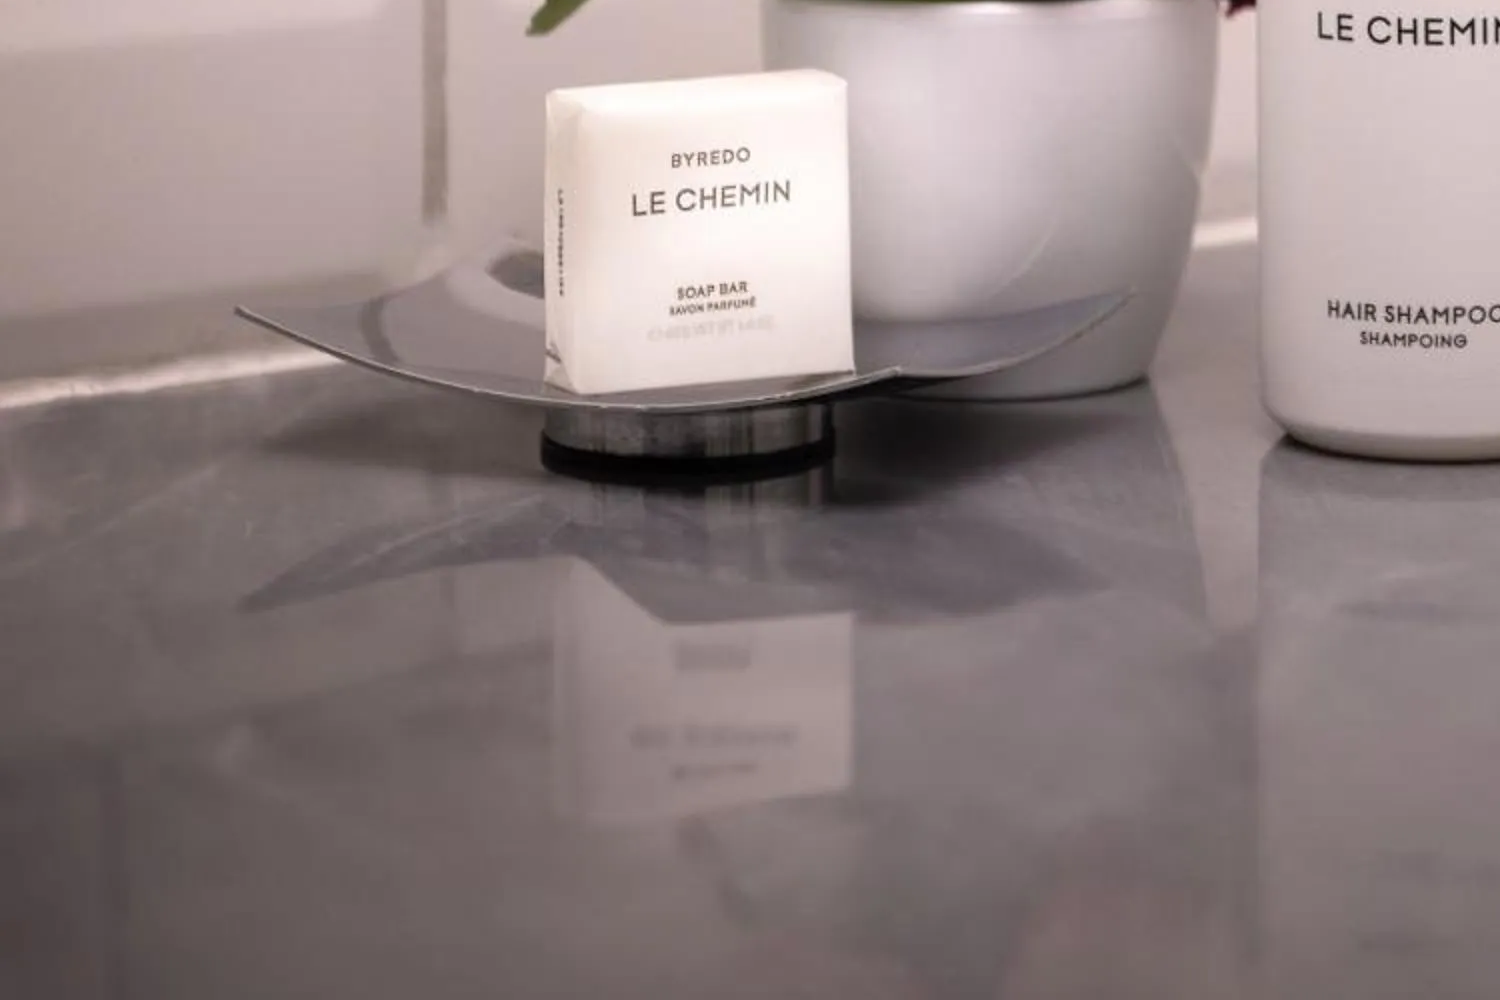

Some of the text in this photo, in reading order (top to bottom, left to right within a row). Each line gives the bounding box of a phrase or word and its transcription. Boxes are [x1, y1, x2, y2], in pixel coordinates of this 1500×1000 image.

[1317, 11, 1355, 42] LE
[670, 146, 751, 169] BYREDO
[631, 180, 791, 217] LE CHEMIN
[677, 280, 748, 301] SOAP BAR
[669, 303, 705, 316] SAVON
[1327, 299, 1377, 323] HAIR
[1359, 330, 1468, 349] SHAMPOING
